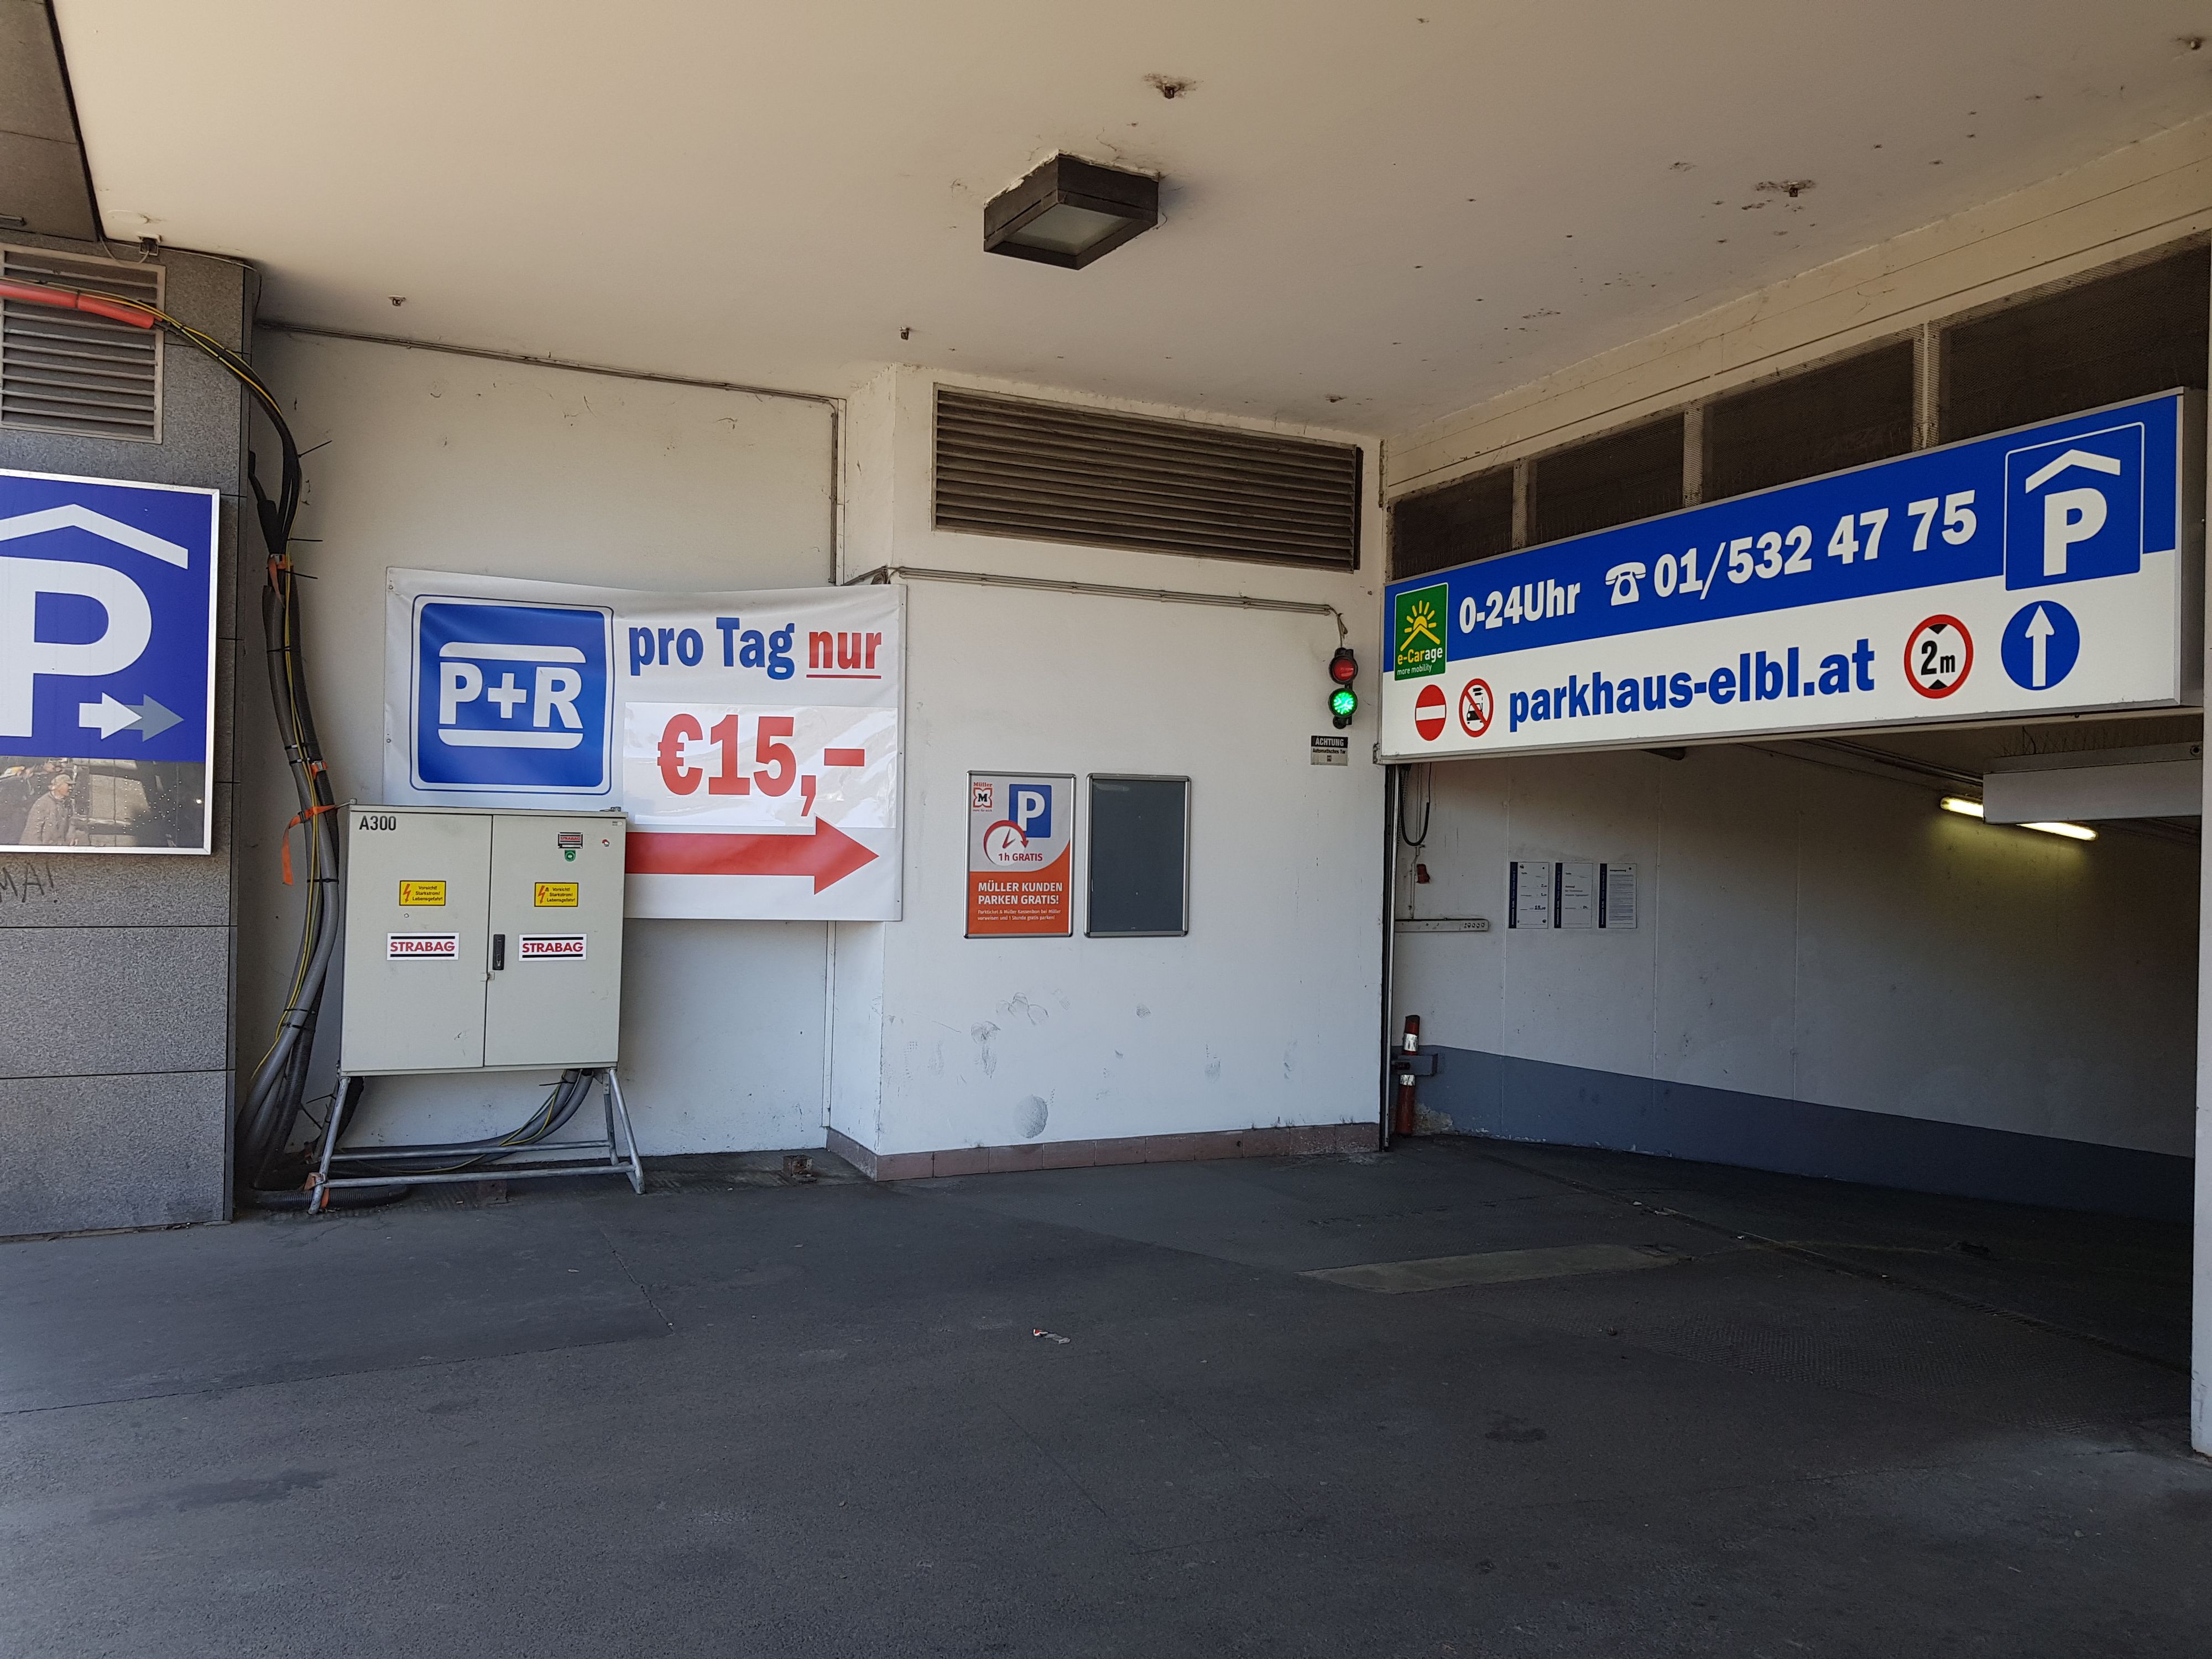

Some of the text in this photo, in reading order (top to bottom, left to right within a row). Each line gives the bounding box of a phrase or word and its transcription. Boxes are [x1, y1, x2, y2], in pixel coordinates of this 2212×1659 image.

[2043, 488, 2107, 576] P
[1459, 489, 1976, 634] 0-24Uhr 01/532 47 75
[0, 556, 152, 737] P
[629, 617, 882, 680] pro Tag nur
[1397, 647, 1443, 665] e-Carage
[1397, 664, 1432, 676] more mobility
[1509, 638, 1875, 733] parkhaus-elbl.at
[439, 661, 584, 729] P+R
[1315, 738, 1344, 747] ACHTUNG
[978, 793, 988, 802] M
[1018, 791, 1045, 831] P
[359, 815, 397, 831] A300
[1013, 853, 1042, 862] GRATIS
[978, 880, 1062, 892] MÜLLER KUNDEN
[978, 895, 1059, 905] PARKEN GRATIS!
[390, 941, 455, 952] STRABAG
[522, 942, 583, 952] STRABAG
